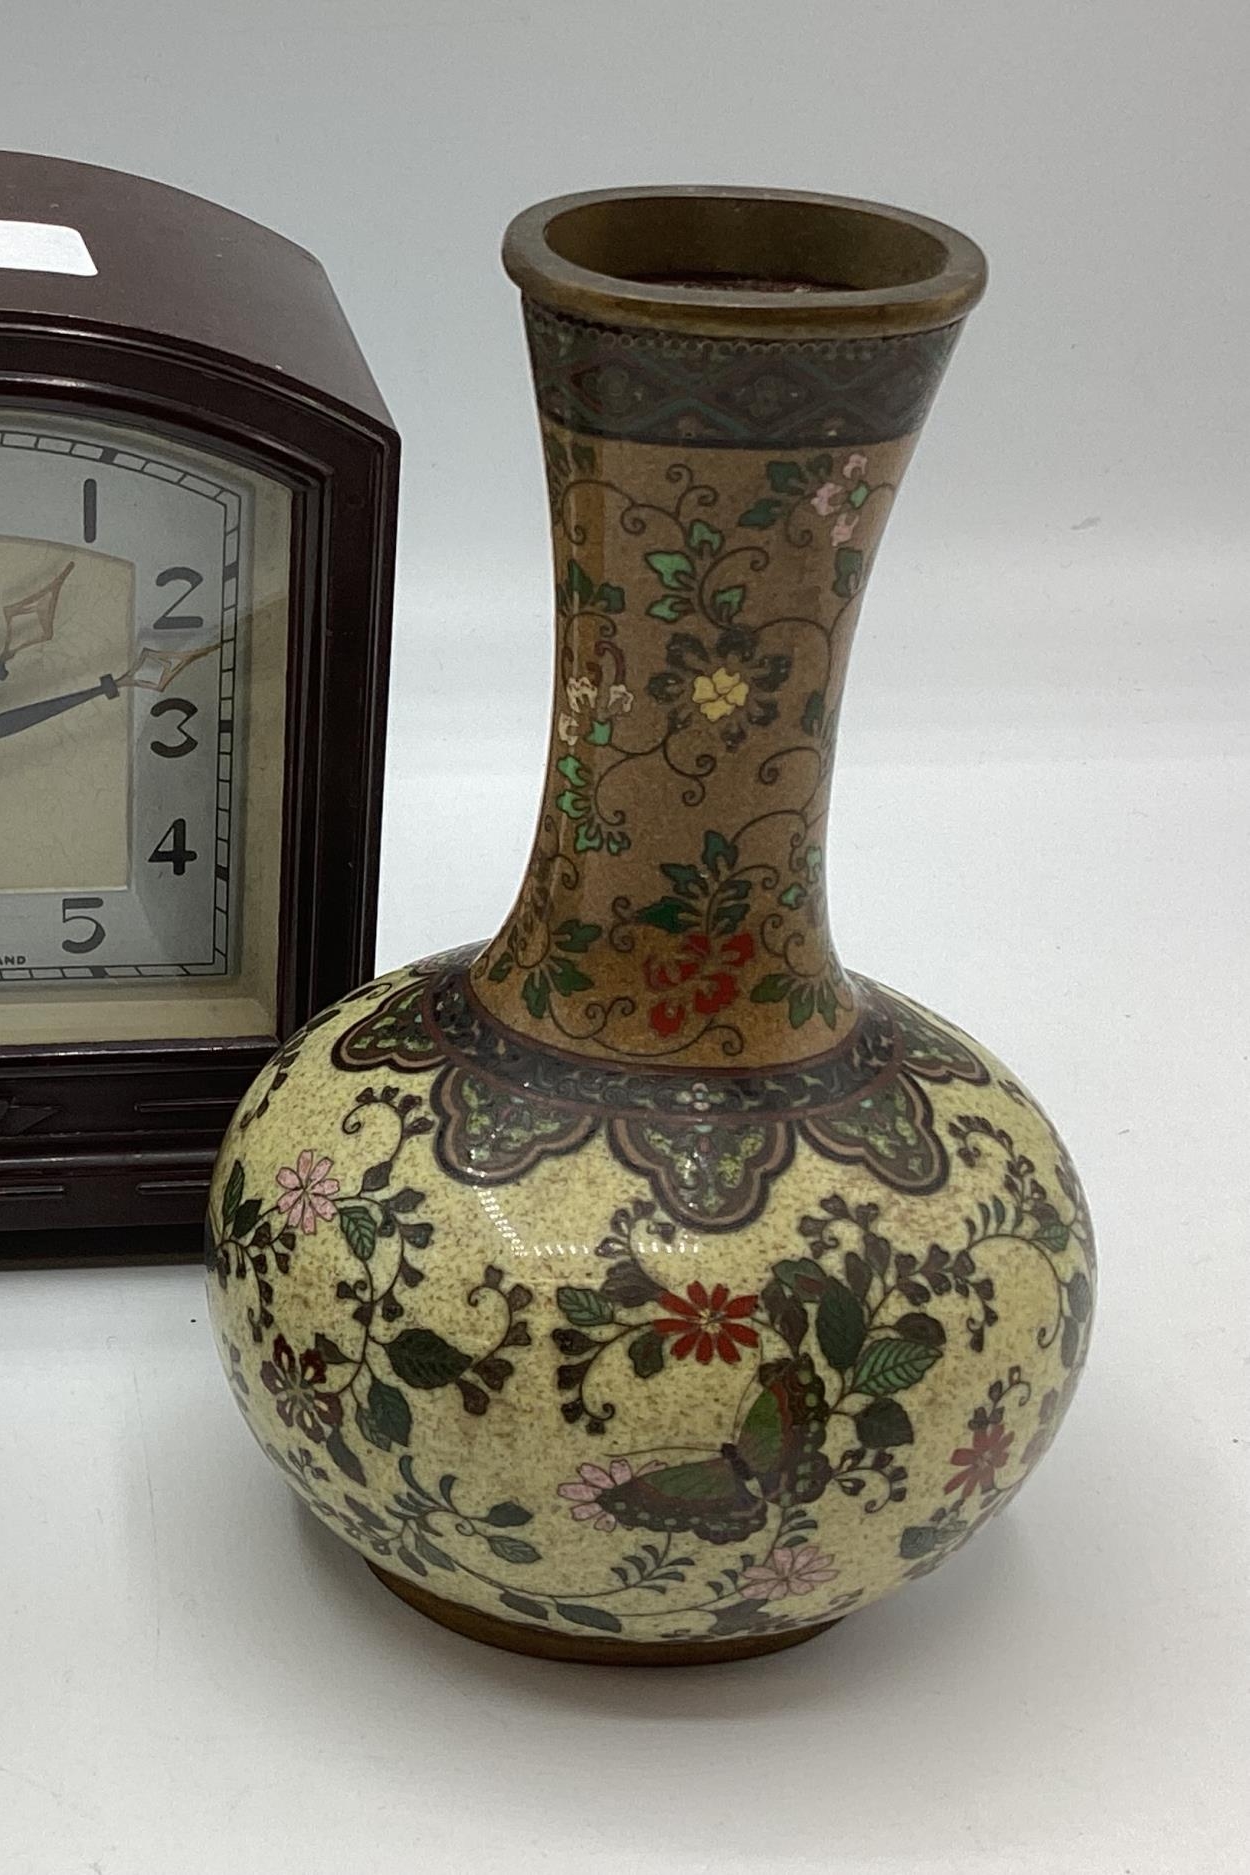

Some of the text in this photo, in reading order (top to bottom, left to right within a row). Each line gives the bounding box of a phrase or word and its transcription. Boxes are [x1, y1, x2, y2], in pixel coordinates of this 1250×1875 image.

[83, 478, 98, 544] 1
[152, 567, 204, 630] 2
[150, 697, 199, 759] 3
[147, 818, 198, 876] 4
[61, 897, 107, 954] 5
